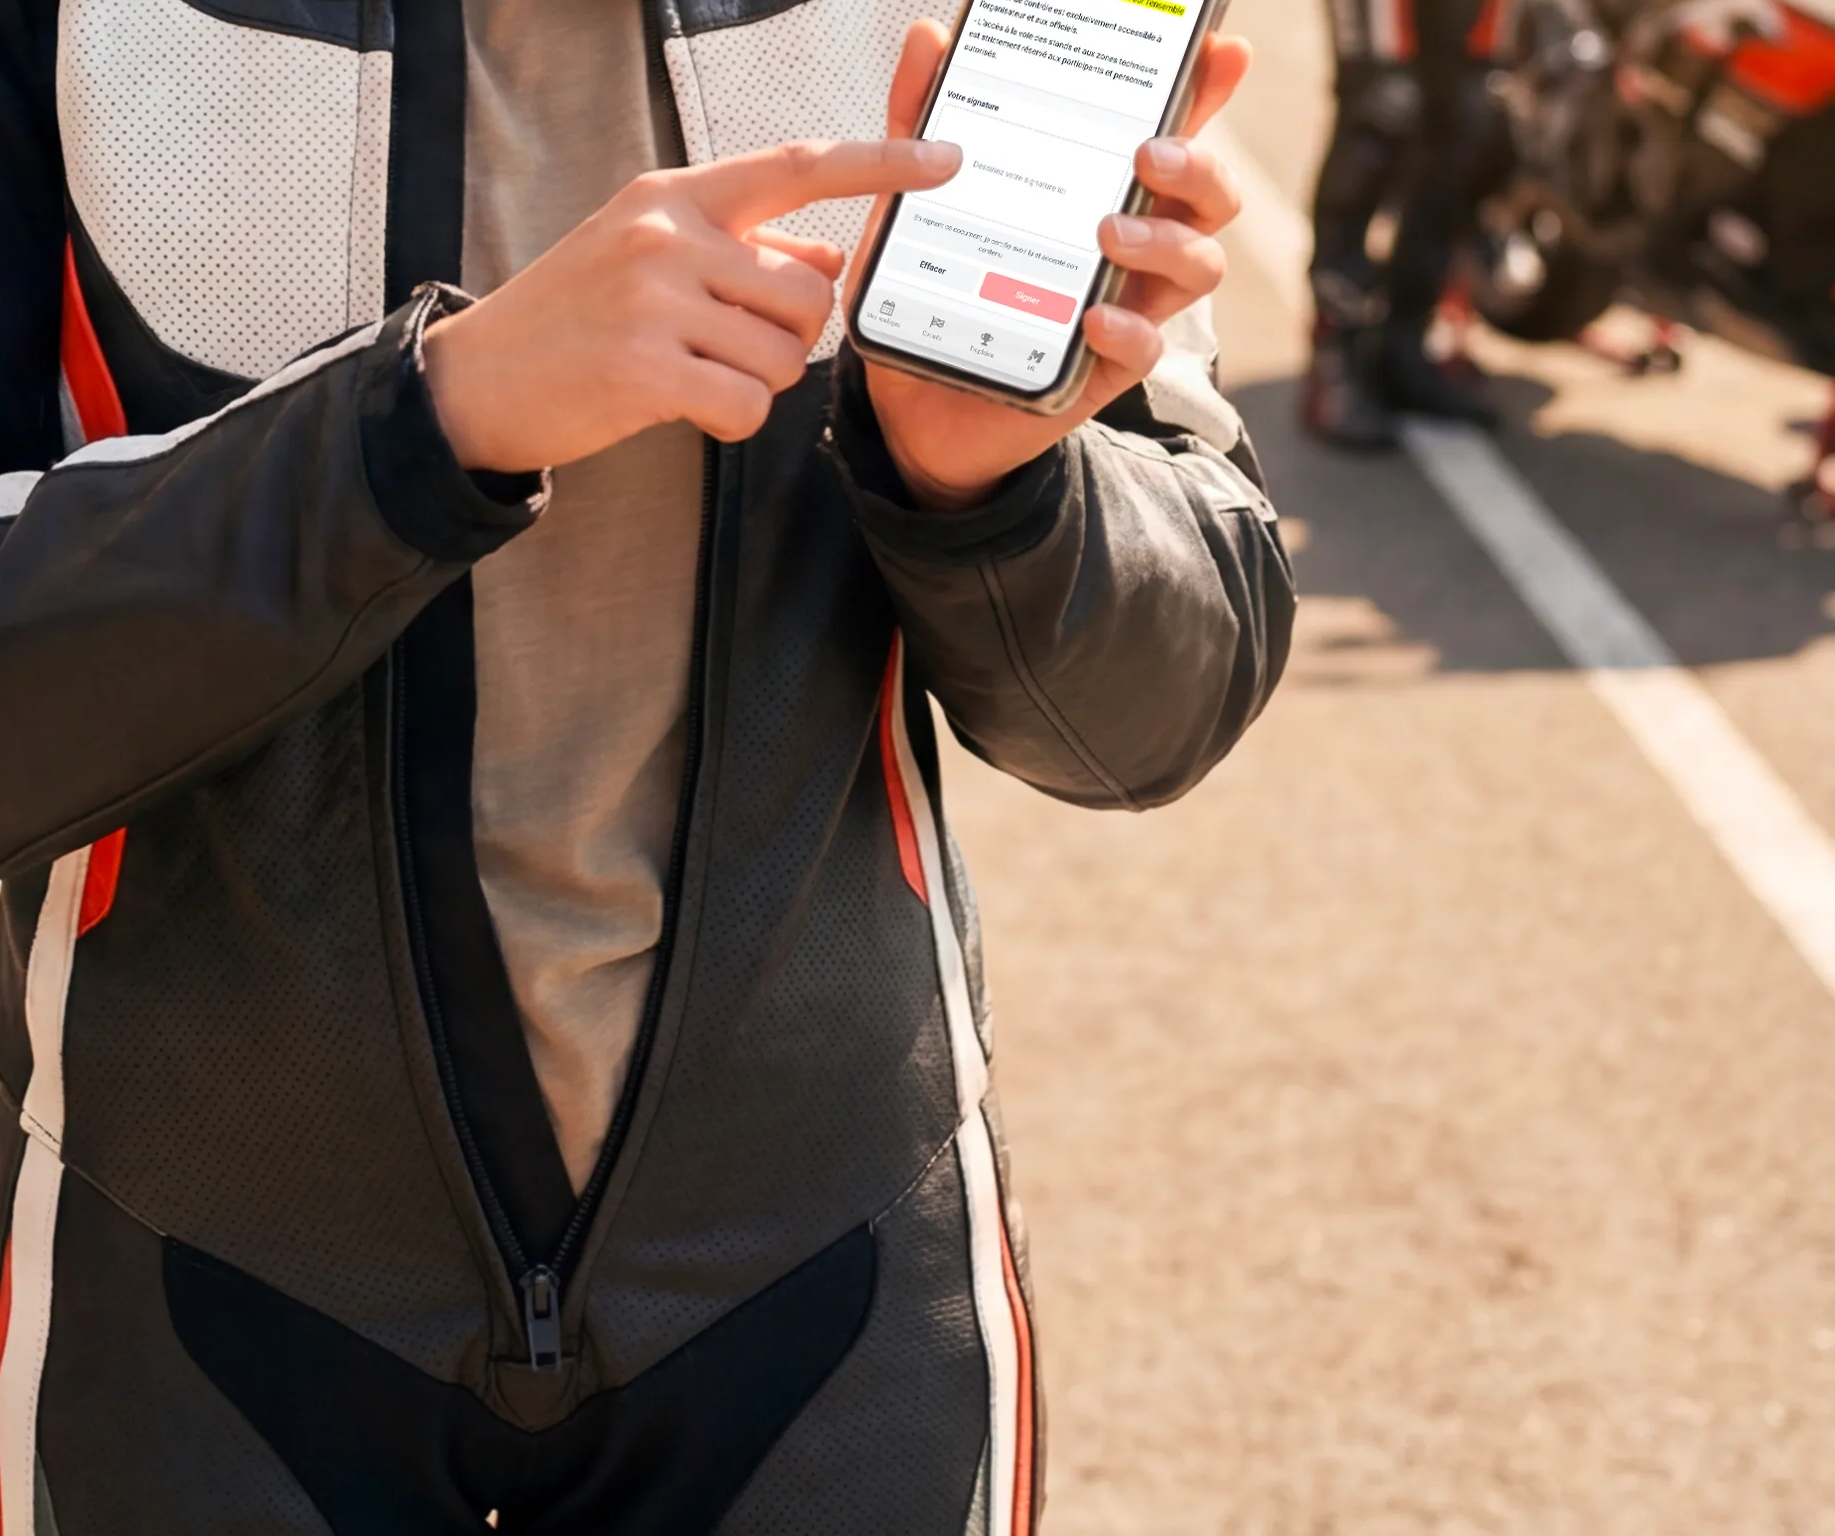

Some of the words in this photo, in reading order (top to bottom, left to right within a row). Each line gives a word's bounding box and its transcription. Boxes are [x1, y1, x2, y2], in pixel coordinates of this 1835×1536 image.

[977, 19, 1004, 31] L'accès
[1081, 49, 1096, 57] aux
[1096, 53, 1118, 64] zones
[947, 90, 966, 101] Votre
[967, 97, 999, 111] signature
[919, 260, 946, 274] Effacer
[1015, 291, 1040, 304] Signer
